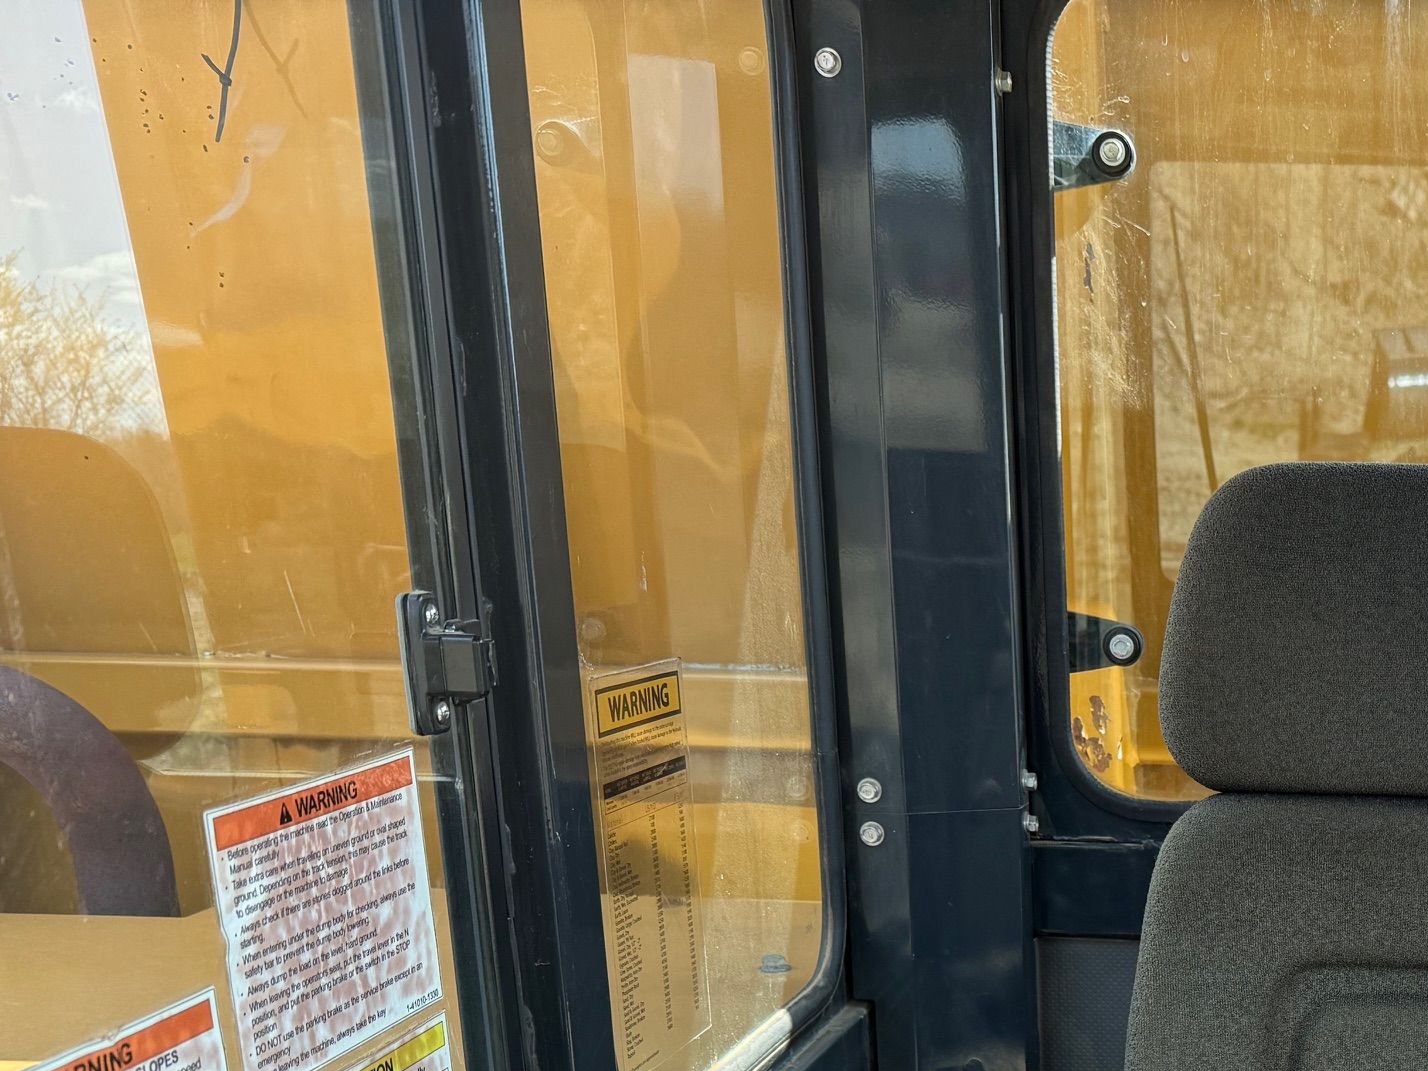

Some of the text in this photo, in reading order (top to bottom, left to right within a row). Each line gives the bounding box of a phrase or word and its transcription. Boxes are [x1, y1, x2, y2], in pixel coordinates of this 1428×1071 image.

[608, 683, 670, 722] WARNING
[294, 780, 357, 817] WARNING
[226, 846, 248, 861] Before
[249, 835, 279, 854] operating
[279, 831, 289, 842] the
[289, 823, 314, 839] machine
[315, 817, 328, 830] read
[328, 815, 338, 825] the
[338, 805, 365, 823] Operation
[370, 792, 402, 810] Maintenance
[229, 848, 279, 874] Manual carefully
[247, 979, 269, 998] Always
[269, 970, 287, 986] dump
[287, 965, 298, 977] the
[298, 958, 311, 972] load
[312, 956, 320, 966] on
[320, 951, 330, 962] the
[345, 936, 358, 950] hard
[248, 997, 268, 1013] When
[268, 986, 291, 1004] leaving
[290, 981, 301, 993] the
[343, 956, 352, 969] put
[352, 951, 361, 962] the
[361, 943, 376, 958] travel
[376, 937, 389, 950] lever
[389, 935, 395, 944] in
[395, 931, 404, 941] the
[403, 927, 409, 937] N
[277, 999, 289, 1013] and
[289, 994, 300, 1009] put
[300, 990, 310, 1002] the
[310, 980, 331, 999] parking
[331, 972, 347, 986] brake
[348, 968, 354, 978] or
[354, 964, 363, 975] the
[364, 954, 380, 970] switch
[380, 952, 386, 961] in
[386, 948, 395, 959] the
[395, 938, 410, 954] STOP
[253, 1021, 277, 1042] position
[257, 1045, 291, 1070] emergency
